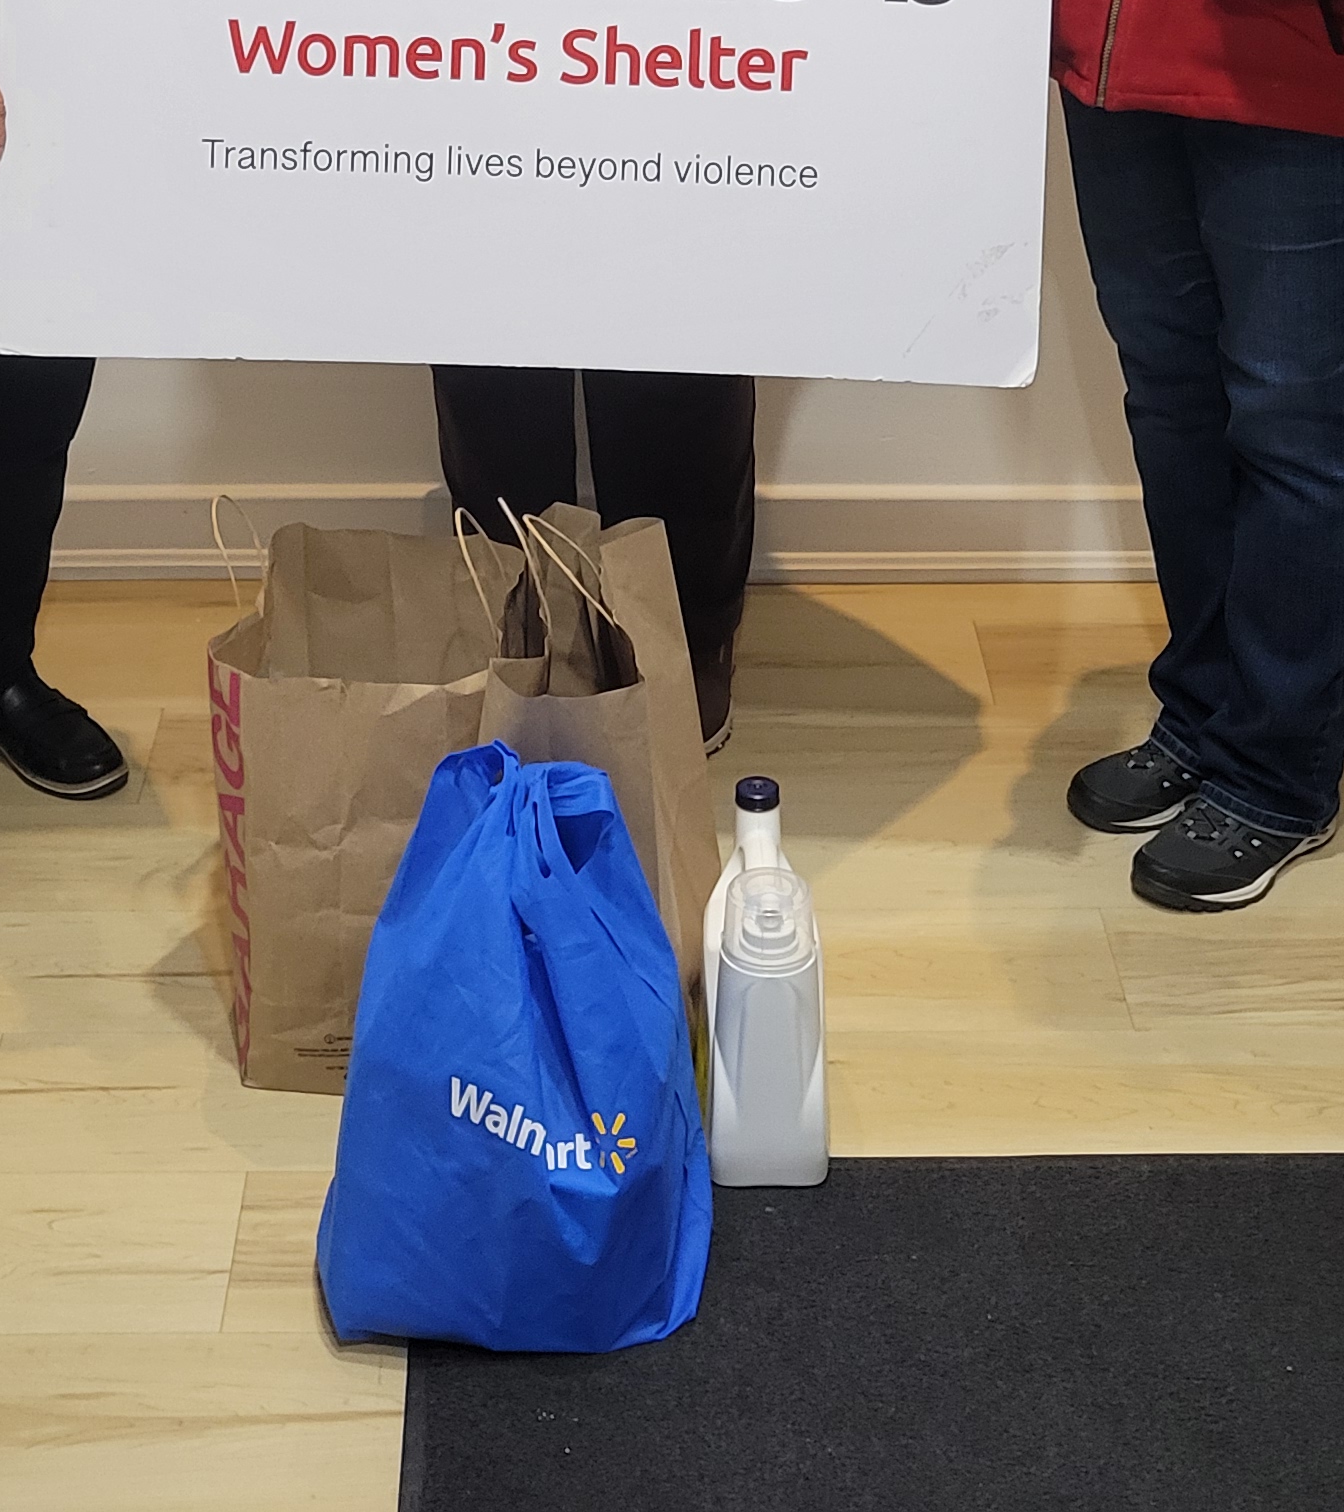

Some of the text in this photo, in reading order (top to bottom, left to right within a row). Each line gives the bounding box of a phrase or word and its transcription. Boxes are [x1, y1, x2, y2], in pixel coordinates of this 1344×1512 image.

[228, 19, 810, 92] Women's Shelter
[201, 138, 818, 189] Transforming lives beyond violence
